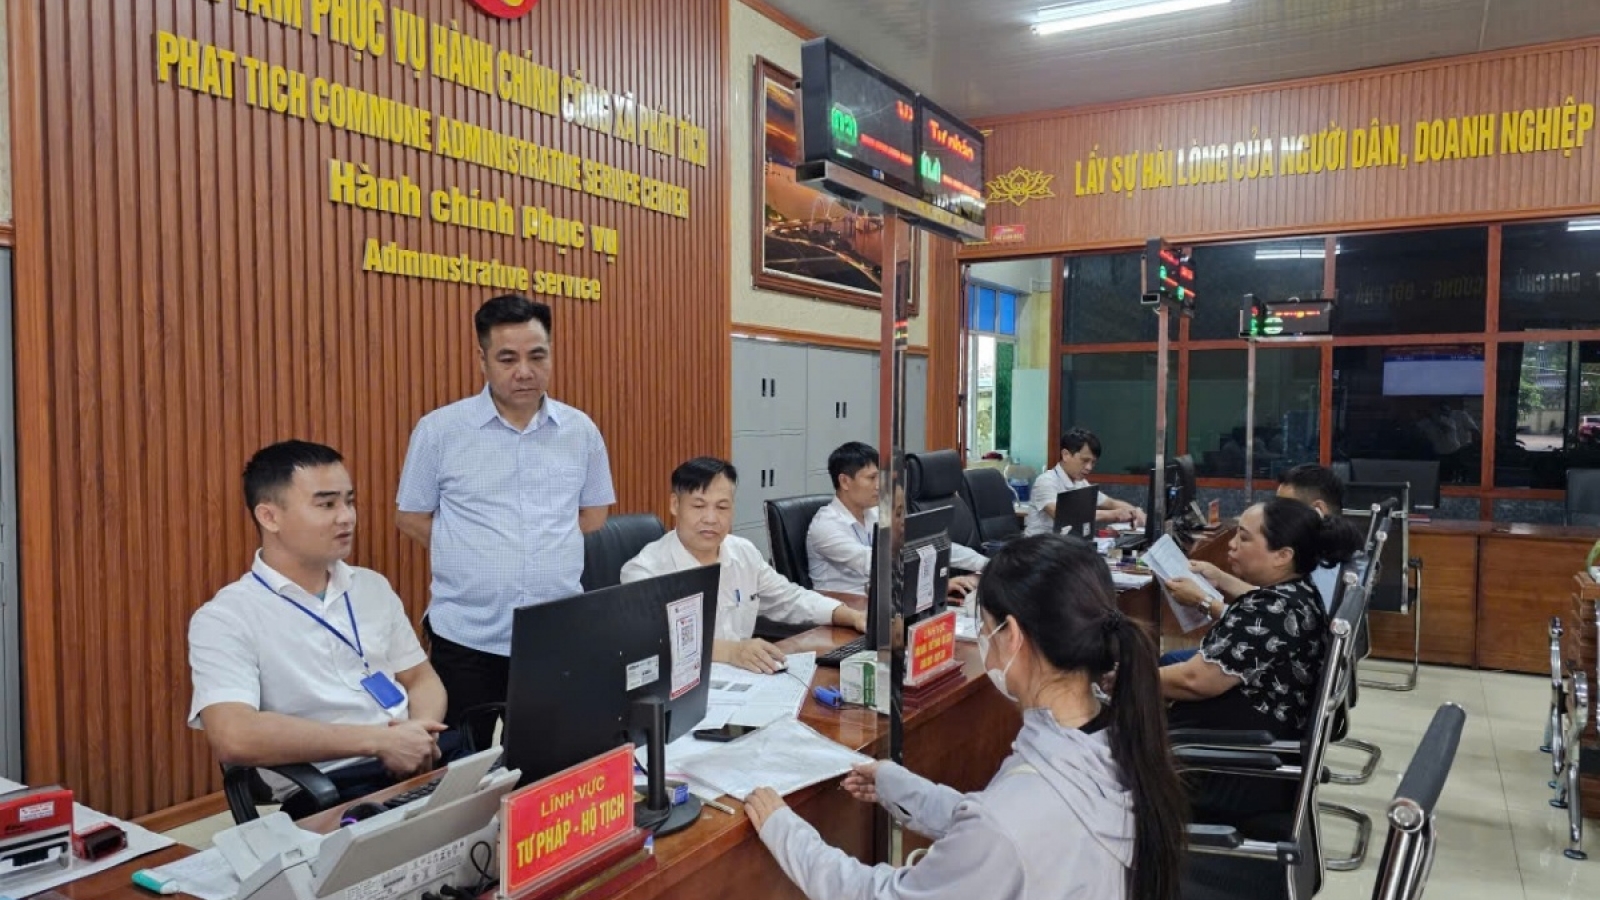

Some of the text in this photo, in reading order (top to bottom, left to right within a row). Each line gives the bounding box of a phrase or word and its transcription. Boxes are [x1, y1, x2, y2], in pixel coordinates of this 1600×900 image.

[311, 0, 385, 61] PHỤC
[392, 6, 425, 78] VỤ
[431, 19, 493, 95] HÀNH
[498, 49, 559, 118] CHÍNH
[561, 69, 610, 135] CÔNG
[157, 30, 689, 219] PHAT TICH COMMUNE ADMINISTRATIVE SERVICE CENTER
[1075, 144, 1108, 196] LẤY
[1111, 151, 1140, 198] SỰ
[1177, 138, 1229, 186] LÒNG
[1232, 126, 1274, 181] CỦA
[1280, 121, 1347, 176] NGƯỜI
[1351, 118, 1407, 170] DÂN,
[1414, 113, 1495, 163] DOANH
[1501, 95, 1594, 157] NGHIỆP
[328, 158, 421, 217] Hành
[431, 187, 514, 235] chính
[590, 224, 618, 263] vụ
[363, 238, 601, 301] Administrative service
[516, 833, 536, 868] TƯ
[536, 817, 571, 859] PHÁP
[581, 801, 598, 836] HỘ
[599, 793, 625, 829] TỊCH
[540, 776, 605, 817] LĨNH VỰC
